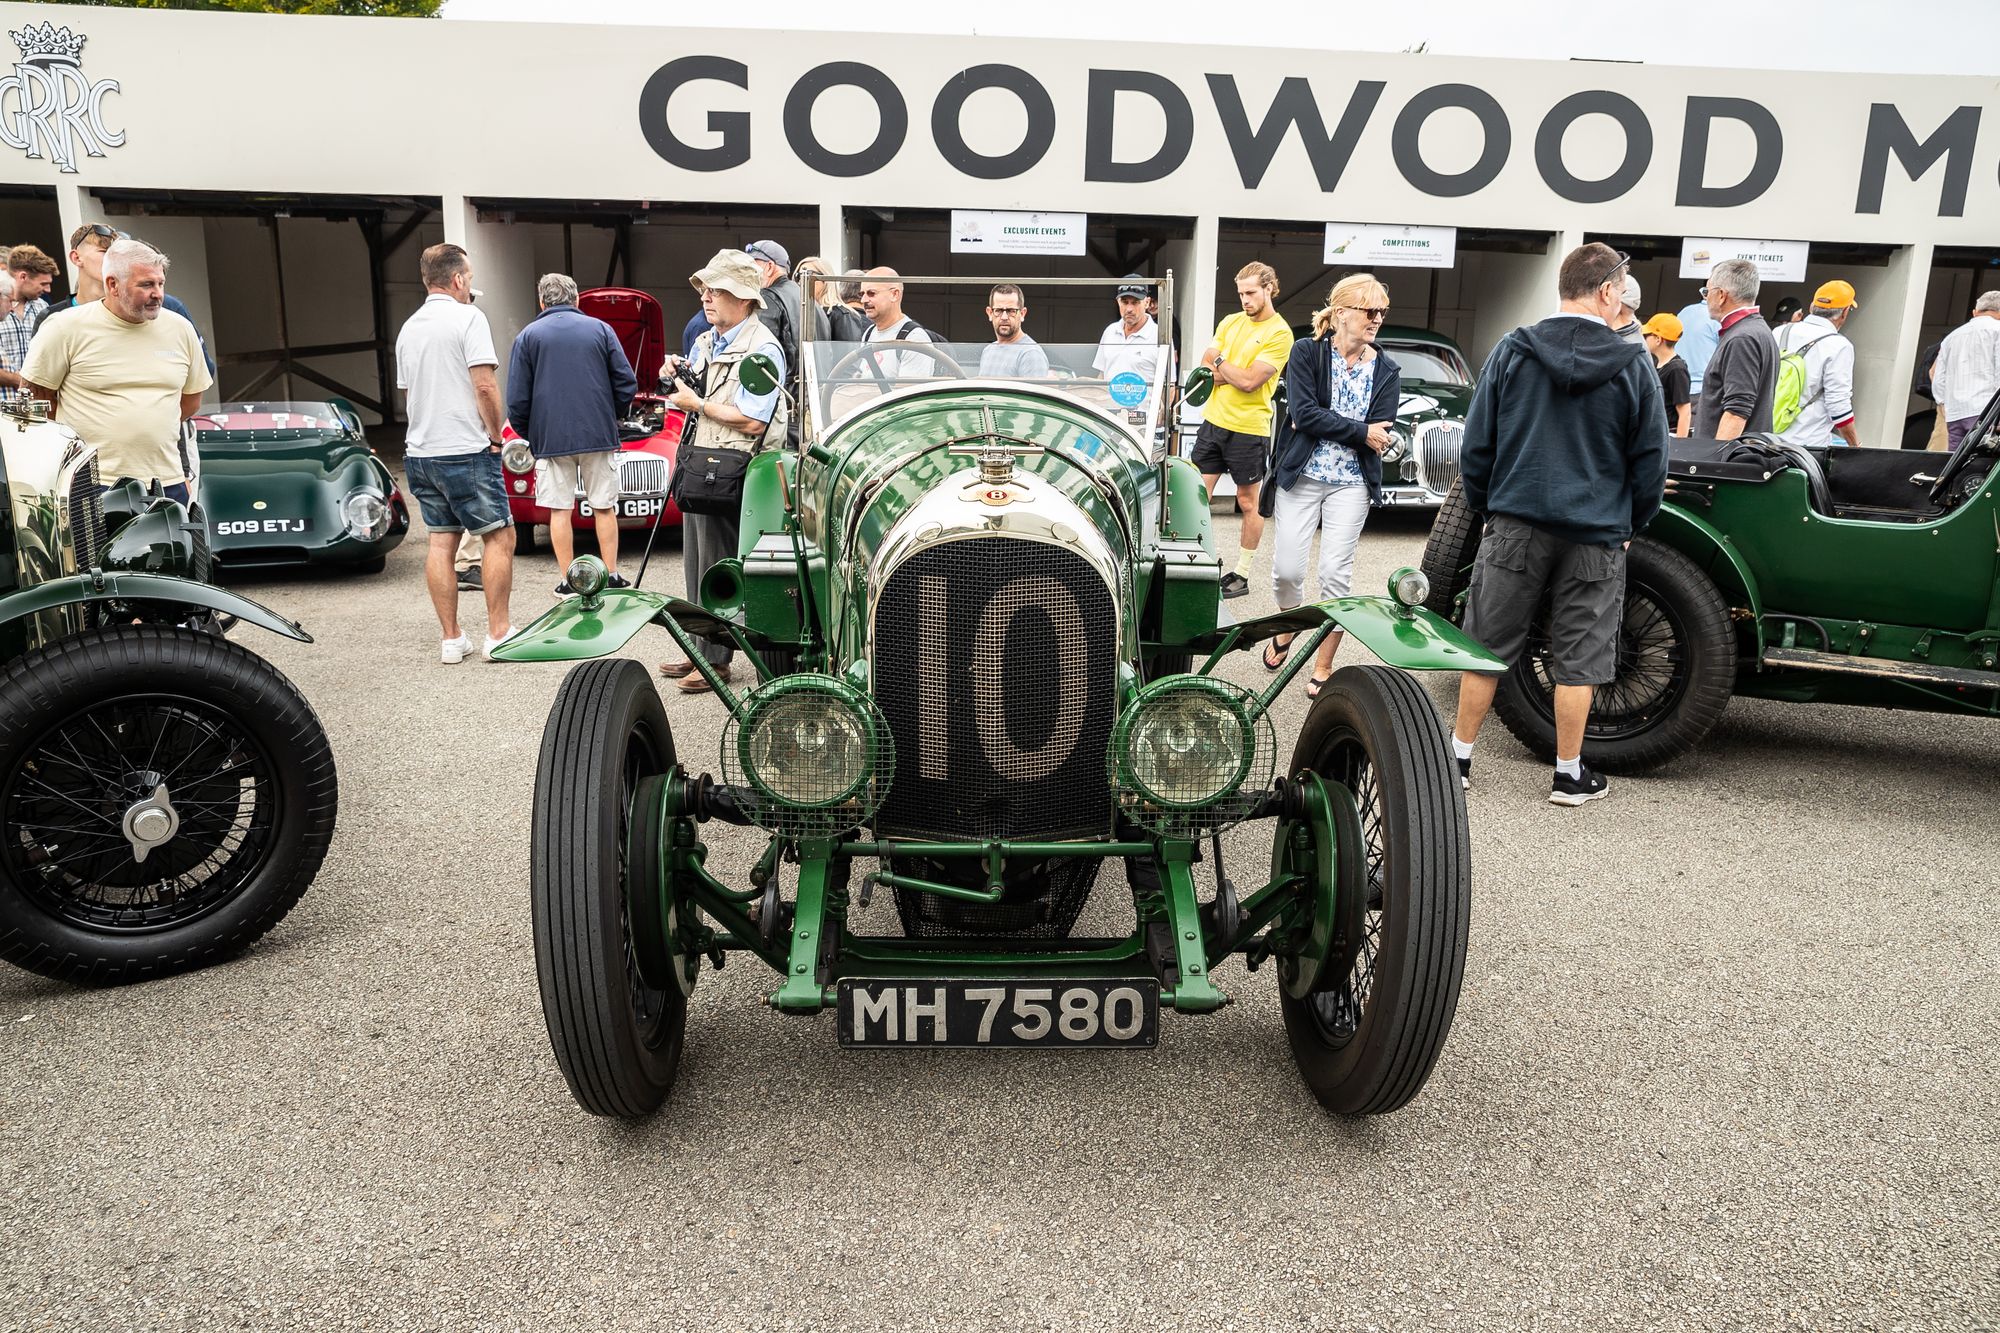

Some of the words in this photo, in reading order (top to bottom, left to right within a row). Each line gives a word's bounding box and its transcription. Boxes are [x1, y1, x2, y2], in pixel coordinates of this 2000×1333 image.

[639, 55, 1784, 208] GOODWOOD
[1855, 103, 2000, 217] M
[1003, 226, 1040, 235] EXCLUSIVE
[1041, 228, 1067, 236] EVENTS
[1382, 239, 1430, 248] COMPETITIONS
[1737, 253, 1757, 262] EVENT
[1758, 254, 1784, 263] TICKETS
[624, 498, 664, 517] GBH
[217, 520, 260, 535] 509
[263, 519, 305, 533] ETJ
[918, 575, 1089, 782] 10
[853, 987, 947, 1042] MH
[964, 987, 1144, 1043] 7580
